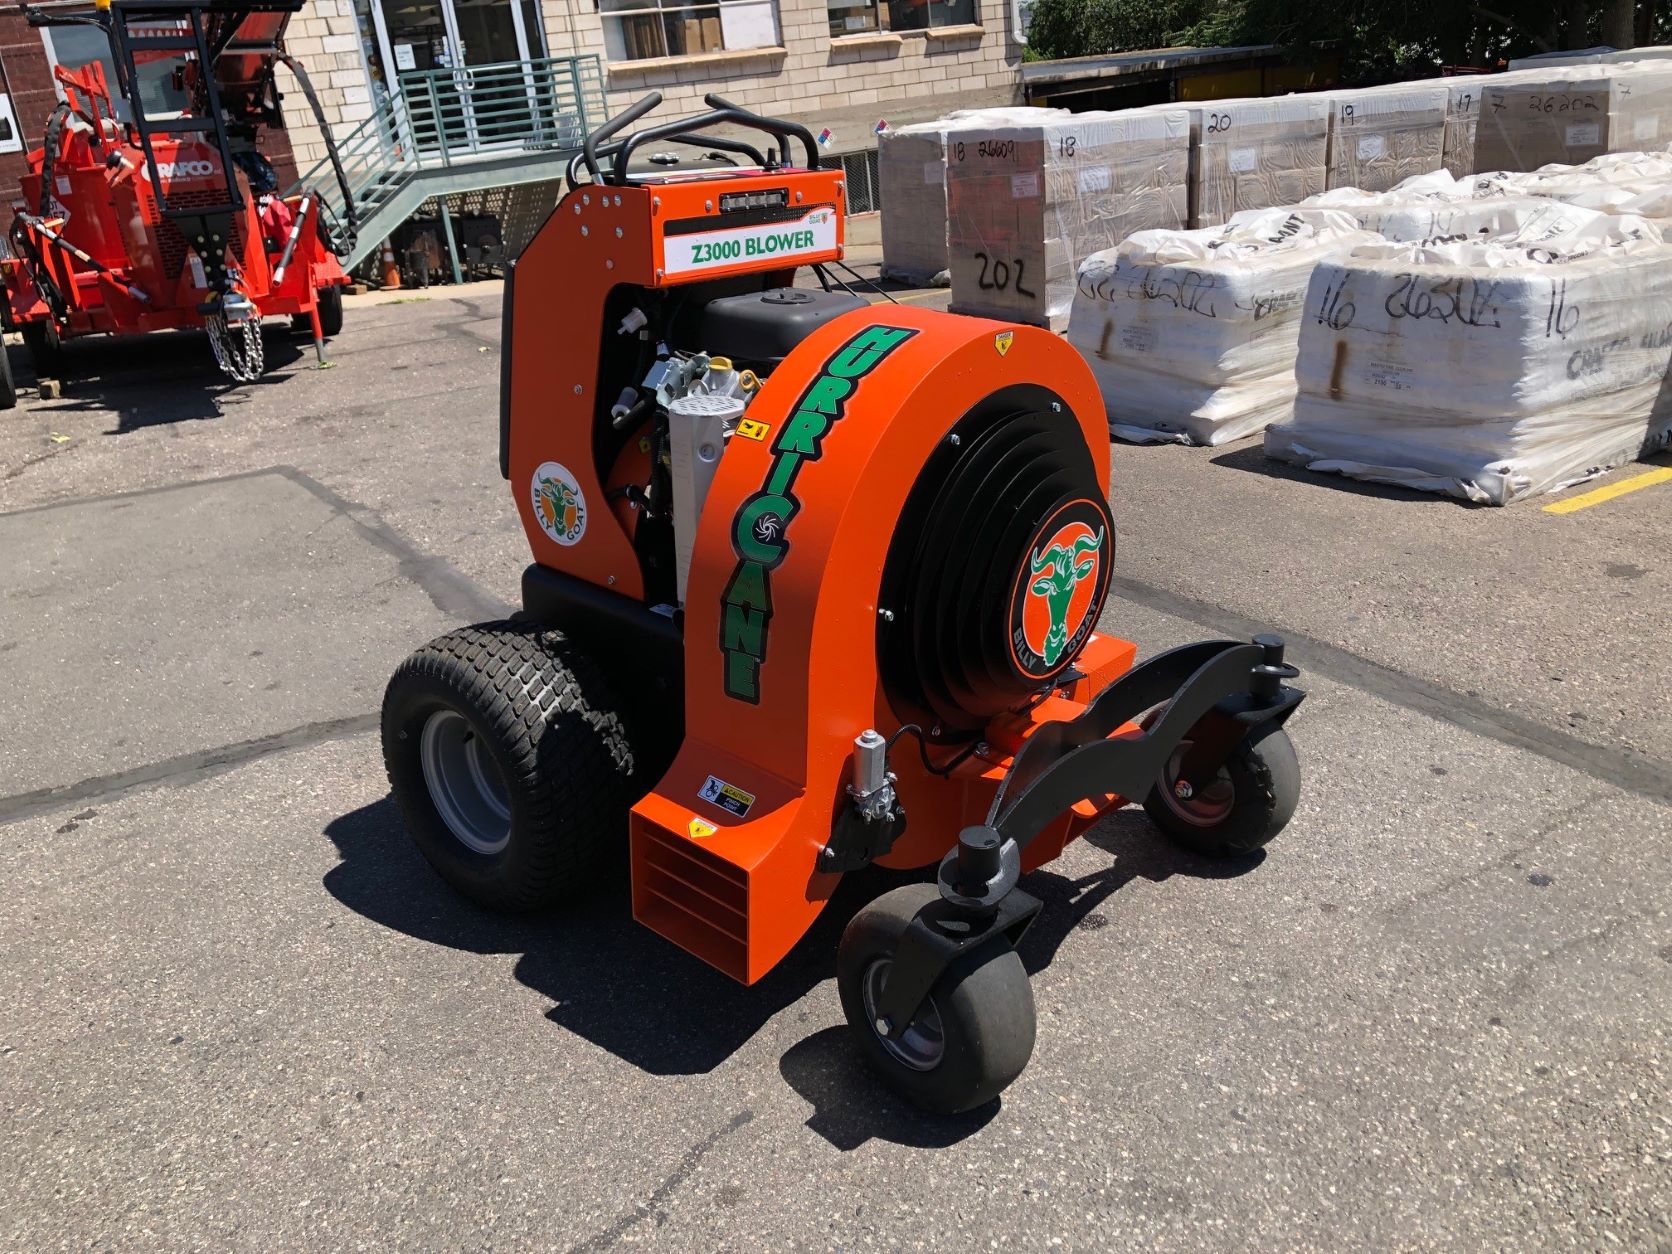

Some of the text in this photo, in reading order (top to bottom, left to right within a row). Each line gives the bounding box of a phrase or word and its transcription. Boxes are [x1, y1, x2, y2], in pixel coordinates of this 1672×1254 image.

[1341, 104, 1355, 126] 19
[1457, 93, 1472, 113] 17
[1207, 112, 1232, 134] 20
[952, 139, 1016, 163] 18 26609
[1060, 135, 1077, 158] 18
[691, 230, 815, 264] Z3000 BLOWER
[974, 252, 1036, 299] 202
[1545, 277, 1580, 340] 16
[534, 487, 584, 541] BILLY GOAT
[722, 324, 916, 701] HURRICANE
[1013, 597, 1099, 670] BILLY GOAT
[726, 787, 750, 803] CAUTION
